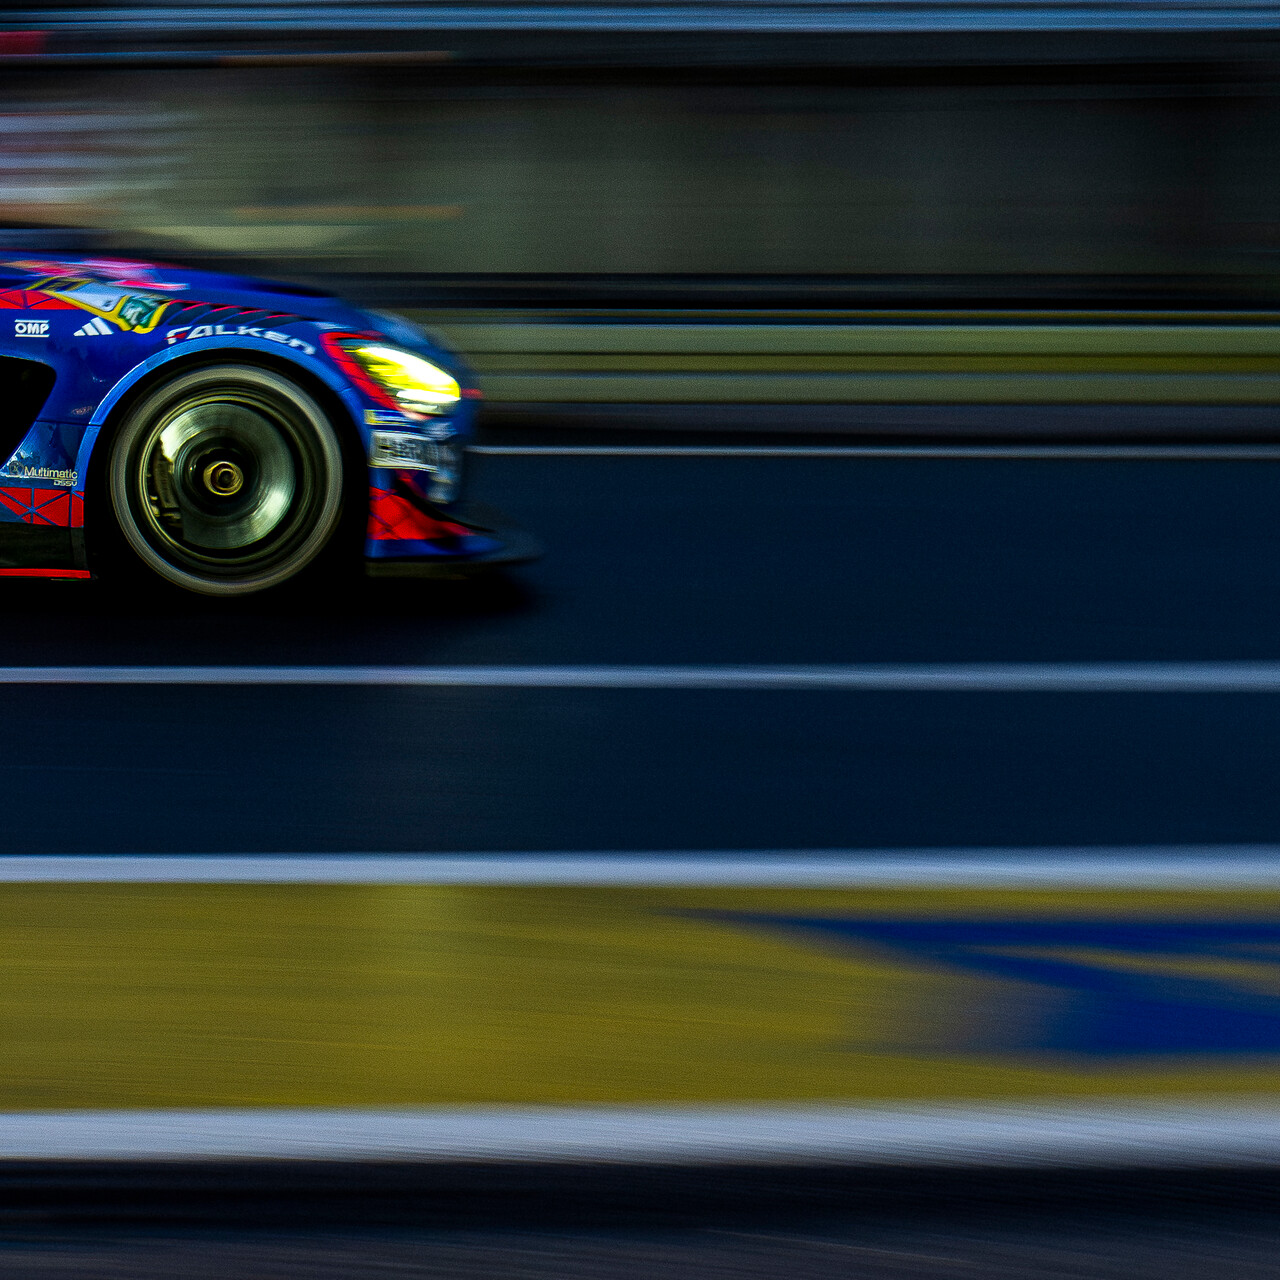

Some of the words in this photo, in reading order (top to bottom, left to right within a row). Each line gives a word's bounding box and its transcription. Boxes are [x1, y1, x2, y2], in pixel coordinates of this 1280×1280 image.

[14, 323, 50, 335] OMP
[166, 324, 317, 355] FALKEN
[23, 465, 78, 479] Multimatic
